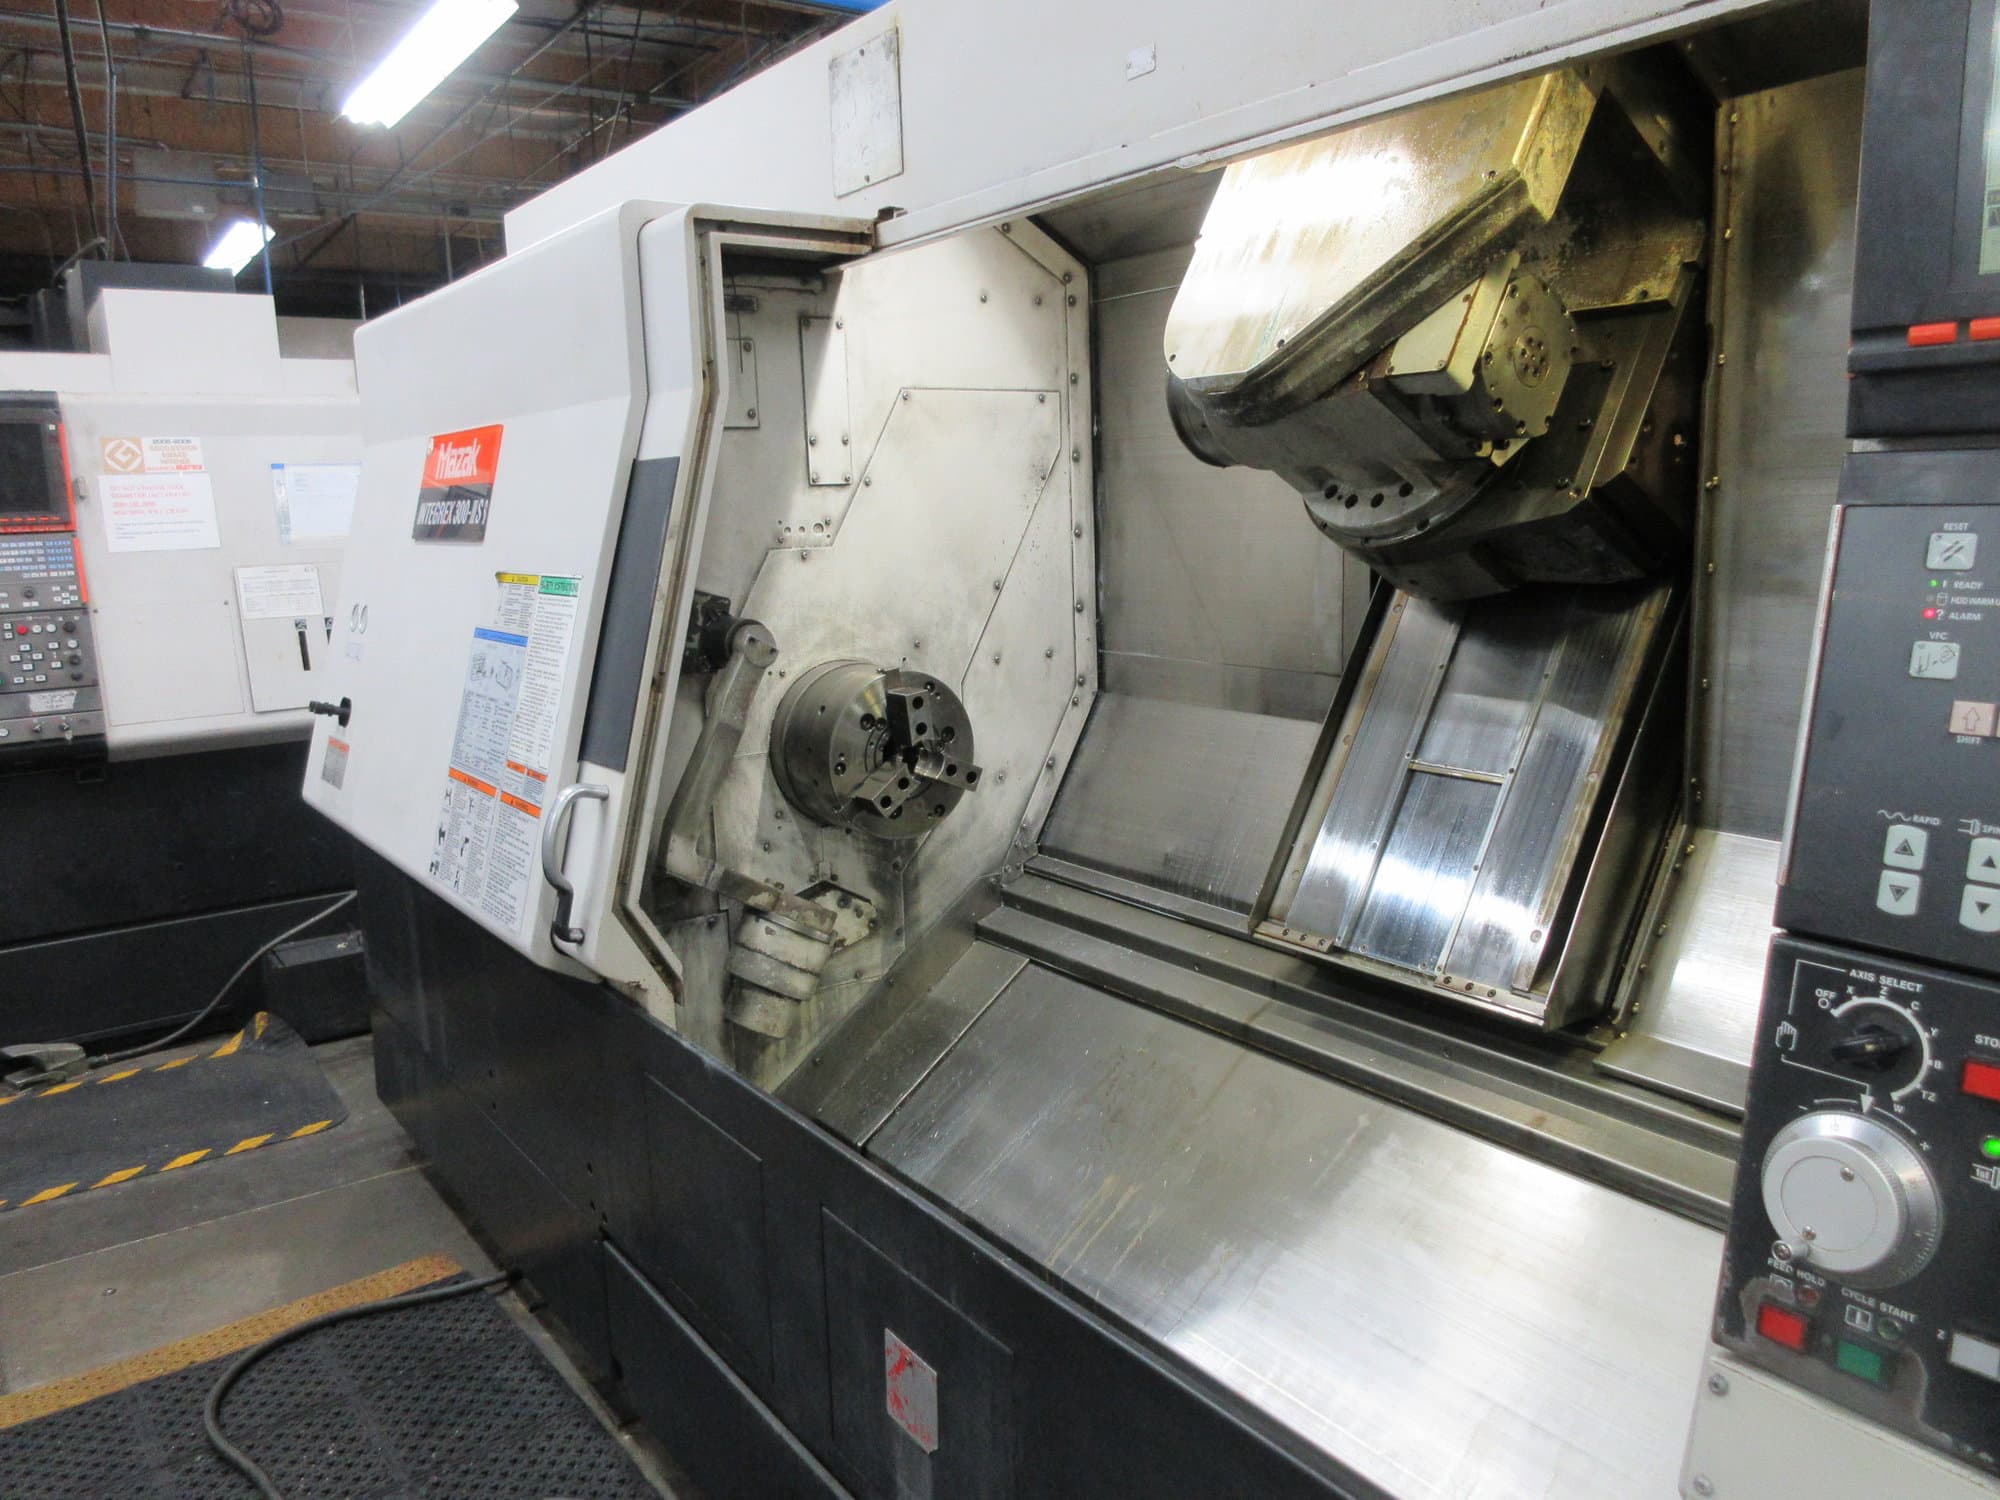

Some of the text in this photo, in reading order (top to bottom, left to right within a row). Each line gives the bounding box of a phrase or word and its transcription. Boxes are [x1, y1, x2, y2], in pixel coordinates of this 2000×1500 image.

[435, 438, 481, 480] Mazak
[417, 500, 456, 525] INTEGREX
[1943, 522, 1969, 531] RESET
[1953, 581, 1984, 589] READY
[1948, 612, 1981, 621] ALARM
[1956, 735, 1981, 744] SHIFT
[1912, 814, 1940, 826] RAPID
[1850, 969, 1923, 993] AXIS SELECT
[1815, 988, 1836, 1000] OFF
[1846, 985, 1854, 994] X
[1879, 985, 1889, 995] Z
[1910, 1001, 1920, 1011] C
[1930, 1027, 1939, 1038] Y
[1975, 1034, 2000, 1050] STO
[1934, 1060, 1942, 1069] B
[1921, 1090, 1936, 1102] TZ
[1893, 1103, 1904, 1113] W
[1767, 1258, 1825, 1288] FEED HOLD
[1841, 1287, 1917, 1324] CYCLE START
